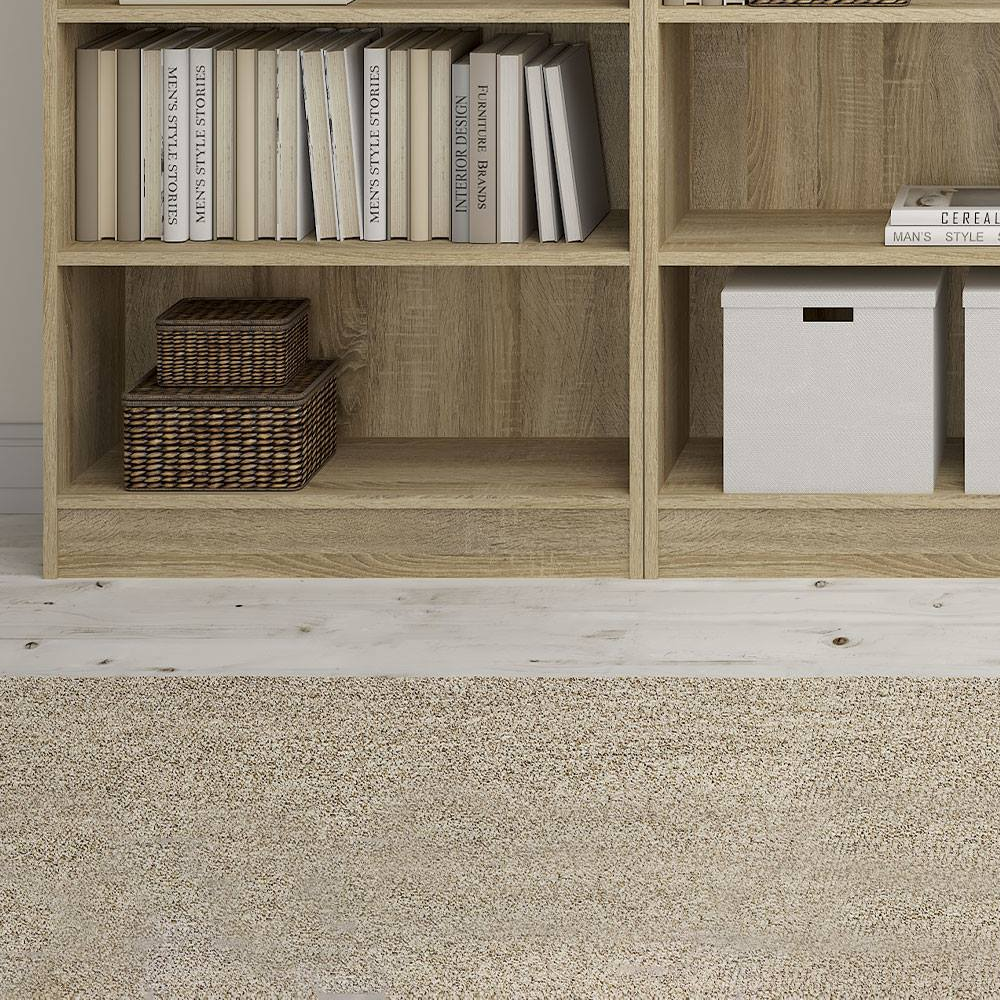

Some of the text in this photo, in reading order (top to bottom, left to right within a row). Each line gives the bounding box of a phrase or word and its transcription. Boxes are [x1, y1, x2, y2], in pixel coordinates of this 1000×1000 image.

[167, 65, 178, 225] MEN'S STYLE STORIES
[195, 65, 206, 224] MEN'S STYLE STORIES
[369, 65, 380, 224] MEN'S STYLE STORIES
[455, 95, 468, 213] INTERIOR DESIGN
[477, 84, 489, 210] FURNITURE BRANDS
[893, 231, 932, 242] MAN'S
[945, 231, 984, 242] STYLE
[941, 211, 1000, 225] CEREAL
